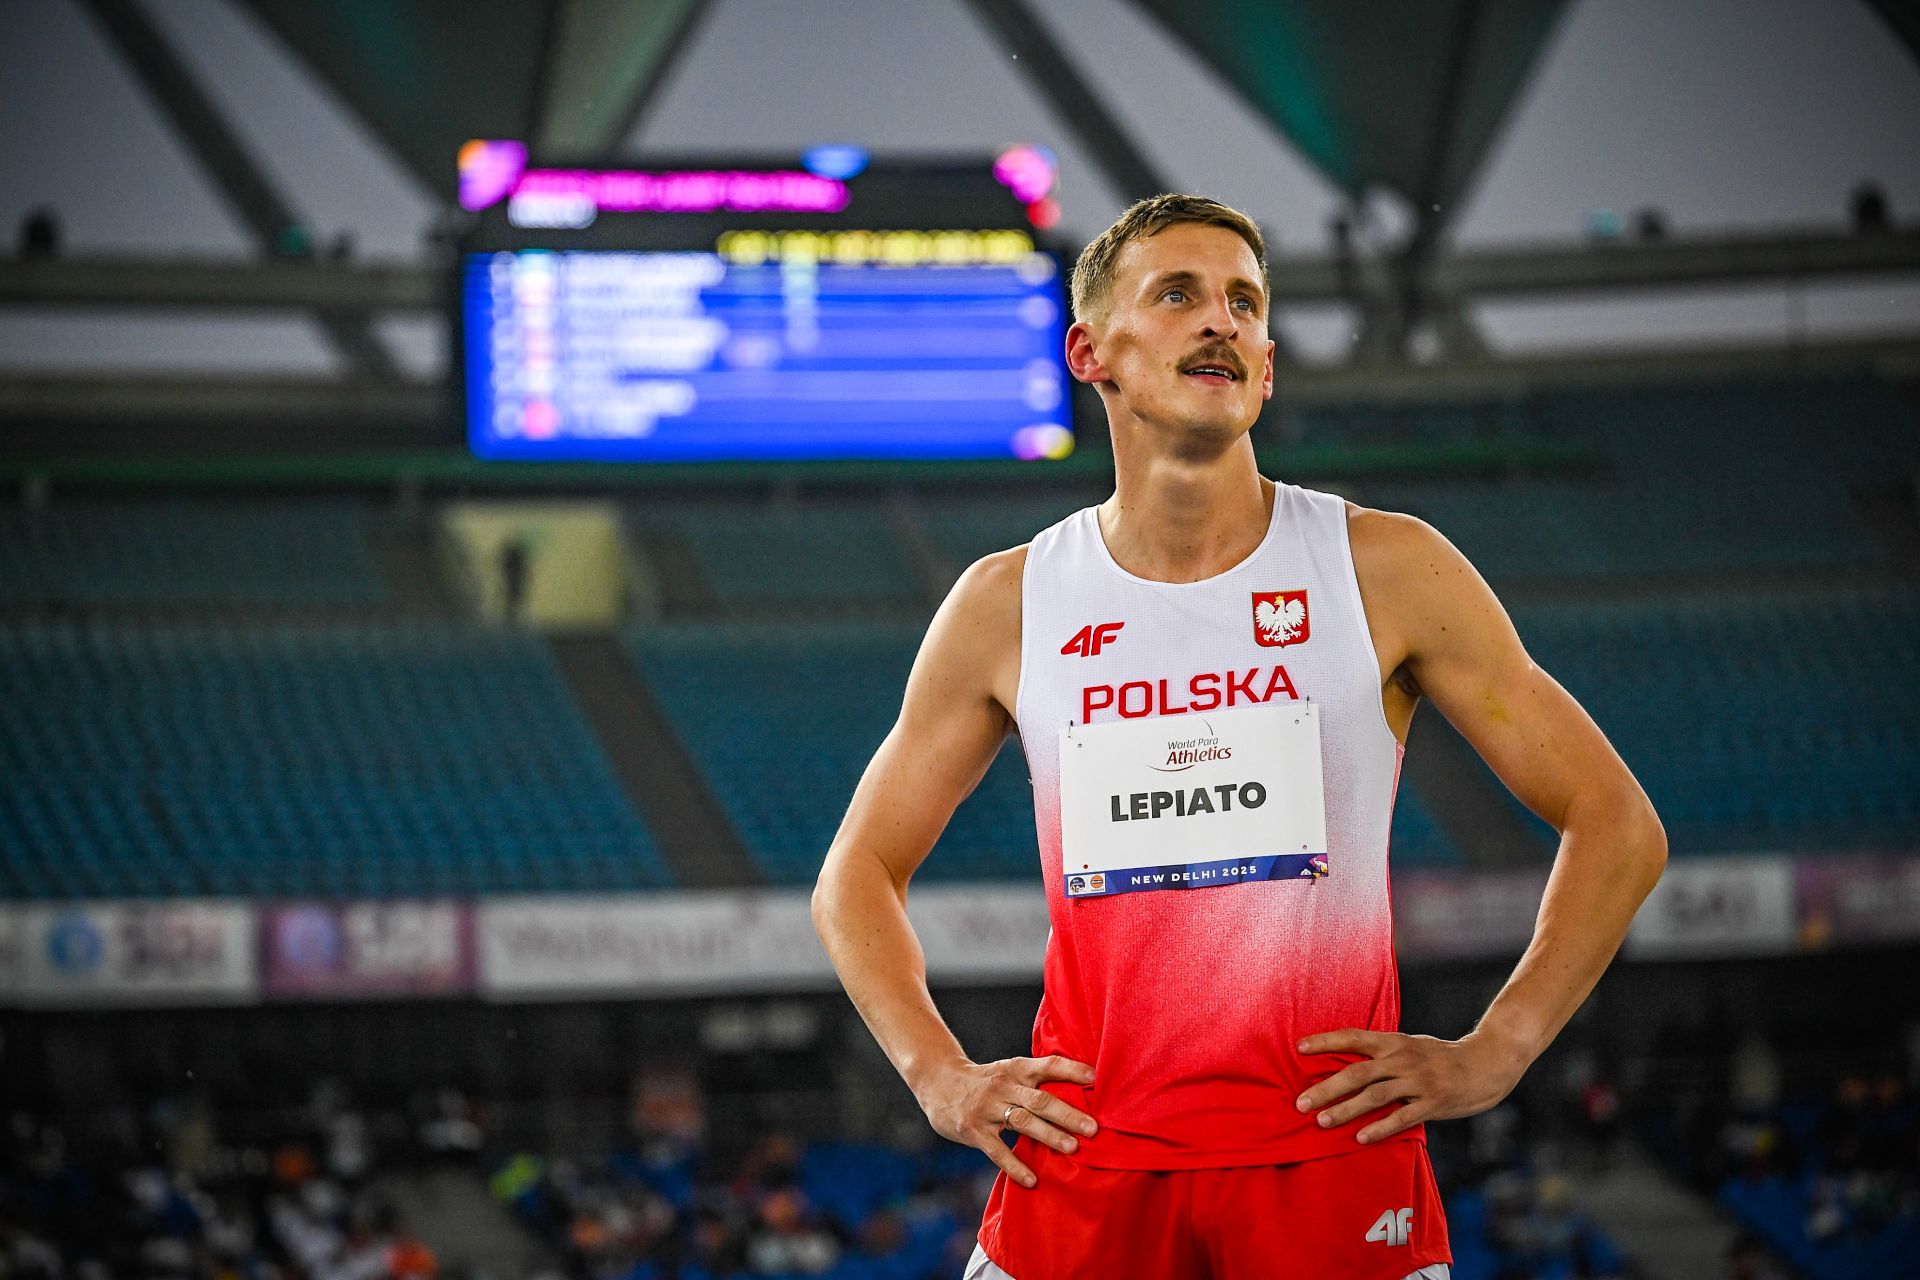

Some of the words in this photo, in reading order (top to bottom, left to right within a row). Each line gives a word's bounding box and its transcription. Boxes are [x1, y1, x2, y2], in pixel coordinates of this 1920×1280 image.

[1060, 621, 1125, 658] 4F
[1082, 664, 1300, 725] POLSKA
[1166, 746, 1232, 766] Athletics
[1167, 739, 1196, 750] World
[1197, 737, 1219, 747] Para
[1110, 780, 1267, 822] LEPIATO
[1131, 873, 1165, 886] NEW
[1171, 869, 1216, 882] DELHI
[1222, 865, 1257, 877] 2025
[1365, 1207, 1414, 1247] 4F
